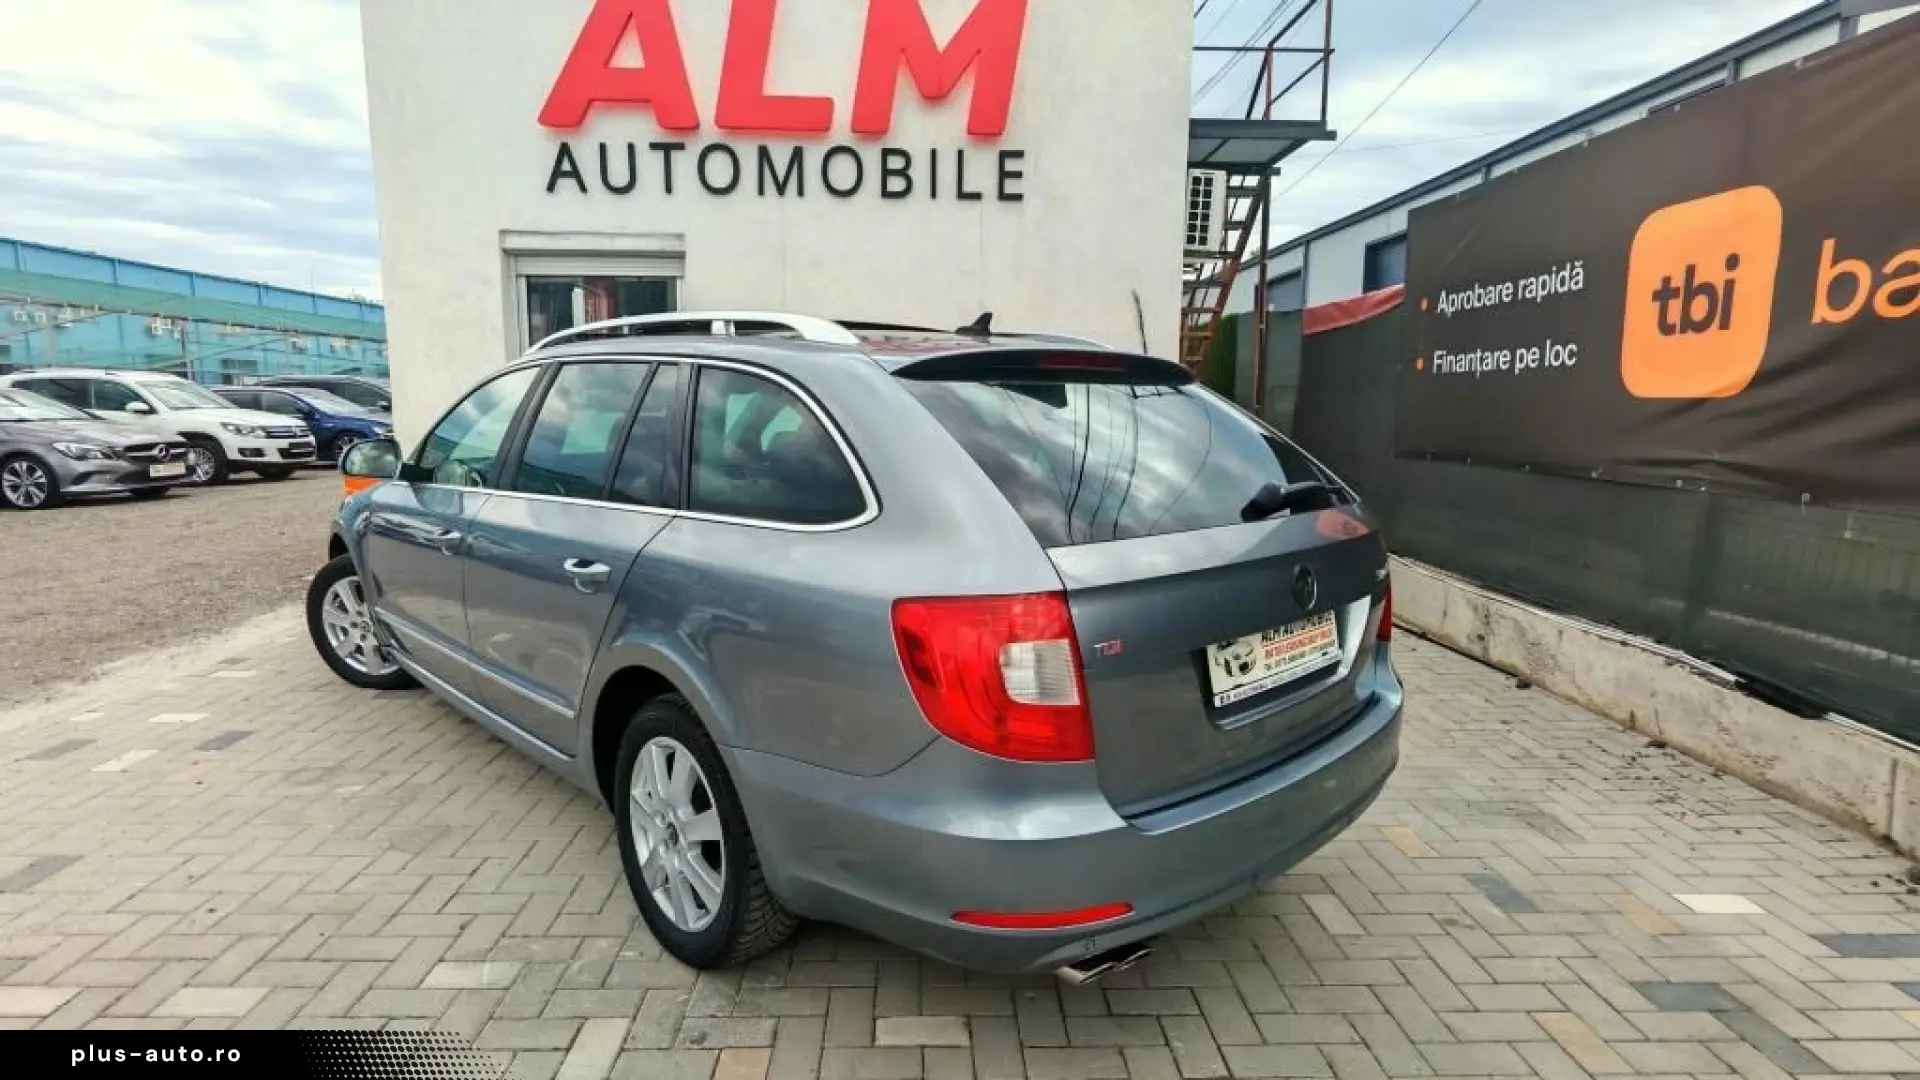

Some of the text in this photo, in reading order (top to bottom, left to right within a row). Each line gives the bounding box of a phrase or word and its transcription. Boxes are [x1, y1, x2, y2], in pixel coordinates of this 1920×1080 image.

[537, 0, 1028, 135] ALM
[546, 142, 1025, 202] AUTOMOBILE
[1436, 260, 1584, 318] Aprobare rapidă
[1651, 253, 1741, 337] tbi
[1514, 346, 1540, 375] pe
[1544, 338, 1578, 367] loc
